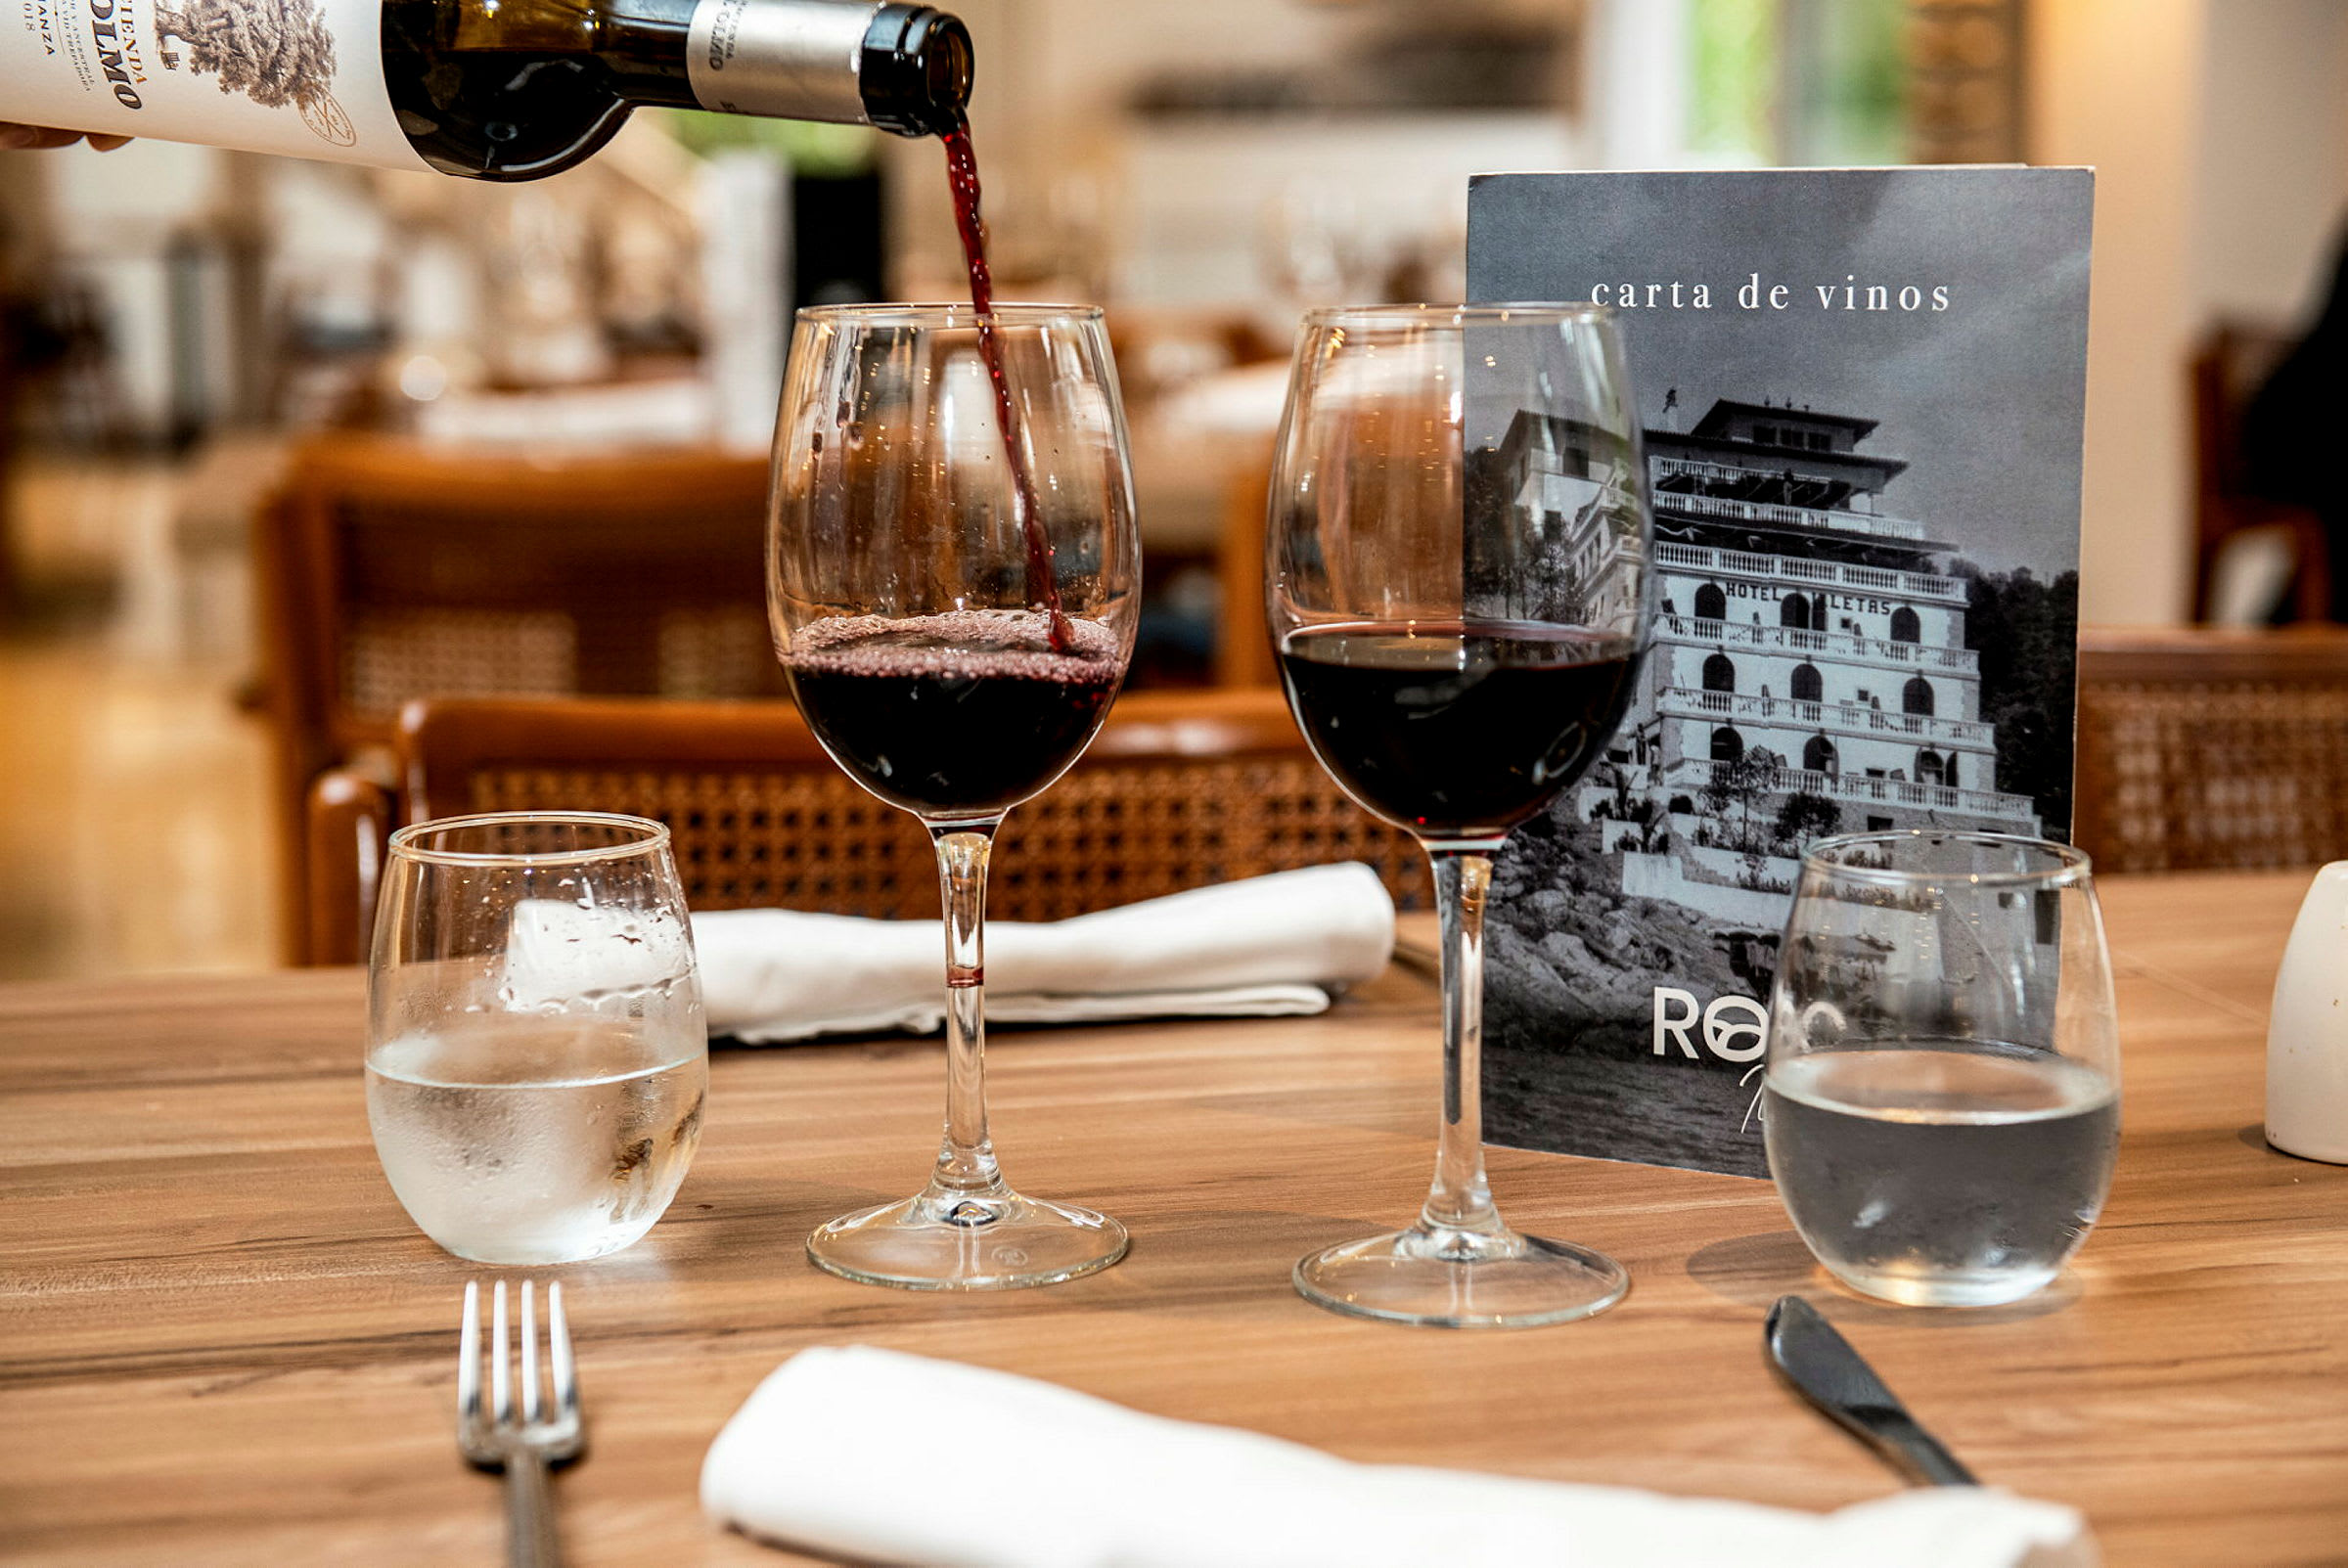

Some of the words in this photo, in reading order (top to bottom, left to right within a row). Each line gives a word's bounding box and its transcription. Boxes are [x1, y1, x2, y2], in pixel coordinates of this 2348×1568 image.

[1591, 280, 1712, 309] carta
[1738, 273, 1789, 310] de
[1816, 275, 1949, 311] vinos
[1726, 582, 1783, 602] HOTEL
